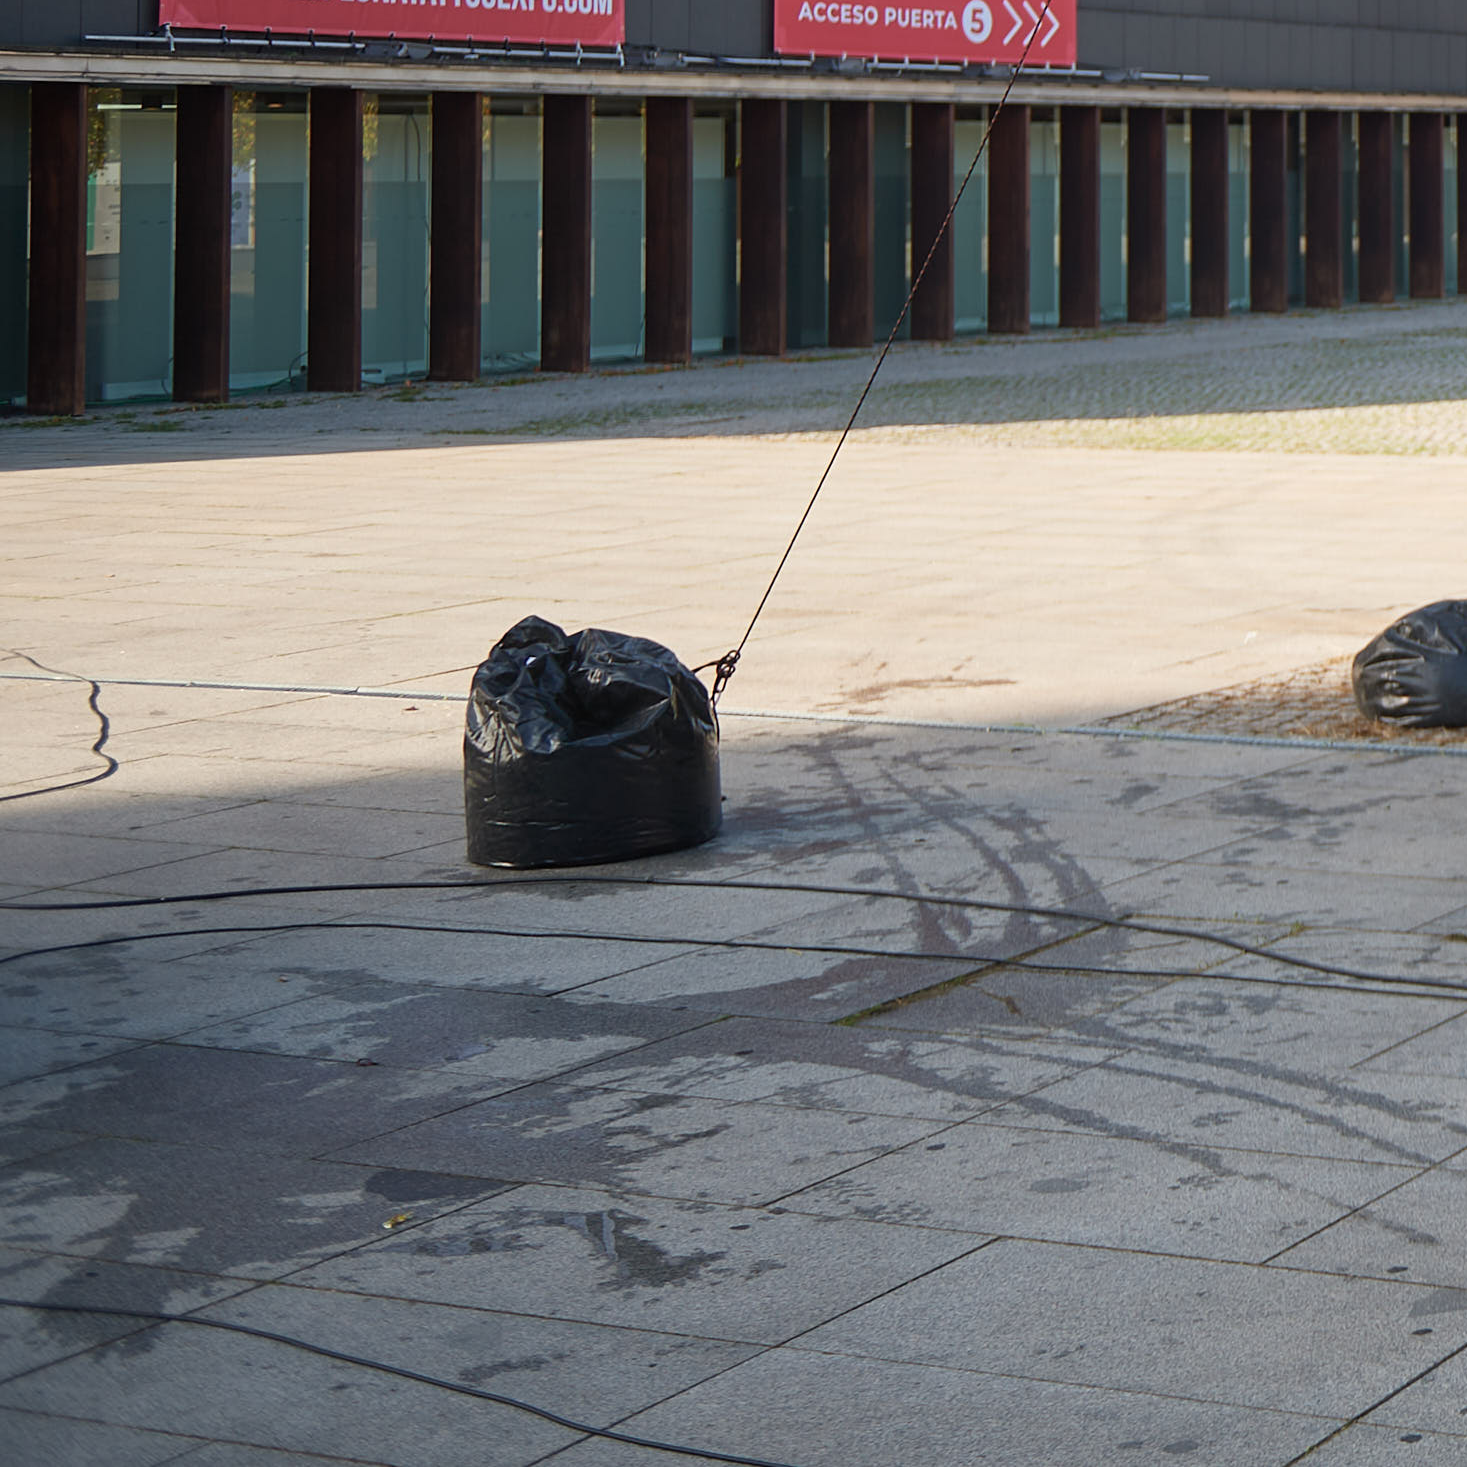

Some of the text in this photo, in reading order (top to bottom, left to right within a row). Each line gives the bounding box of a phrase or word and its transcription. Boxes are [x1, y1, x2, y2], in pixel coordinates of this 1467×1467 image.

[798, 1, 985, 34] ACCESO PUERTA 5
